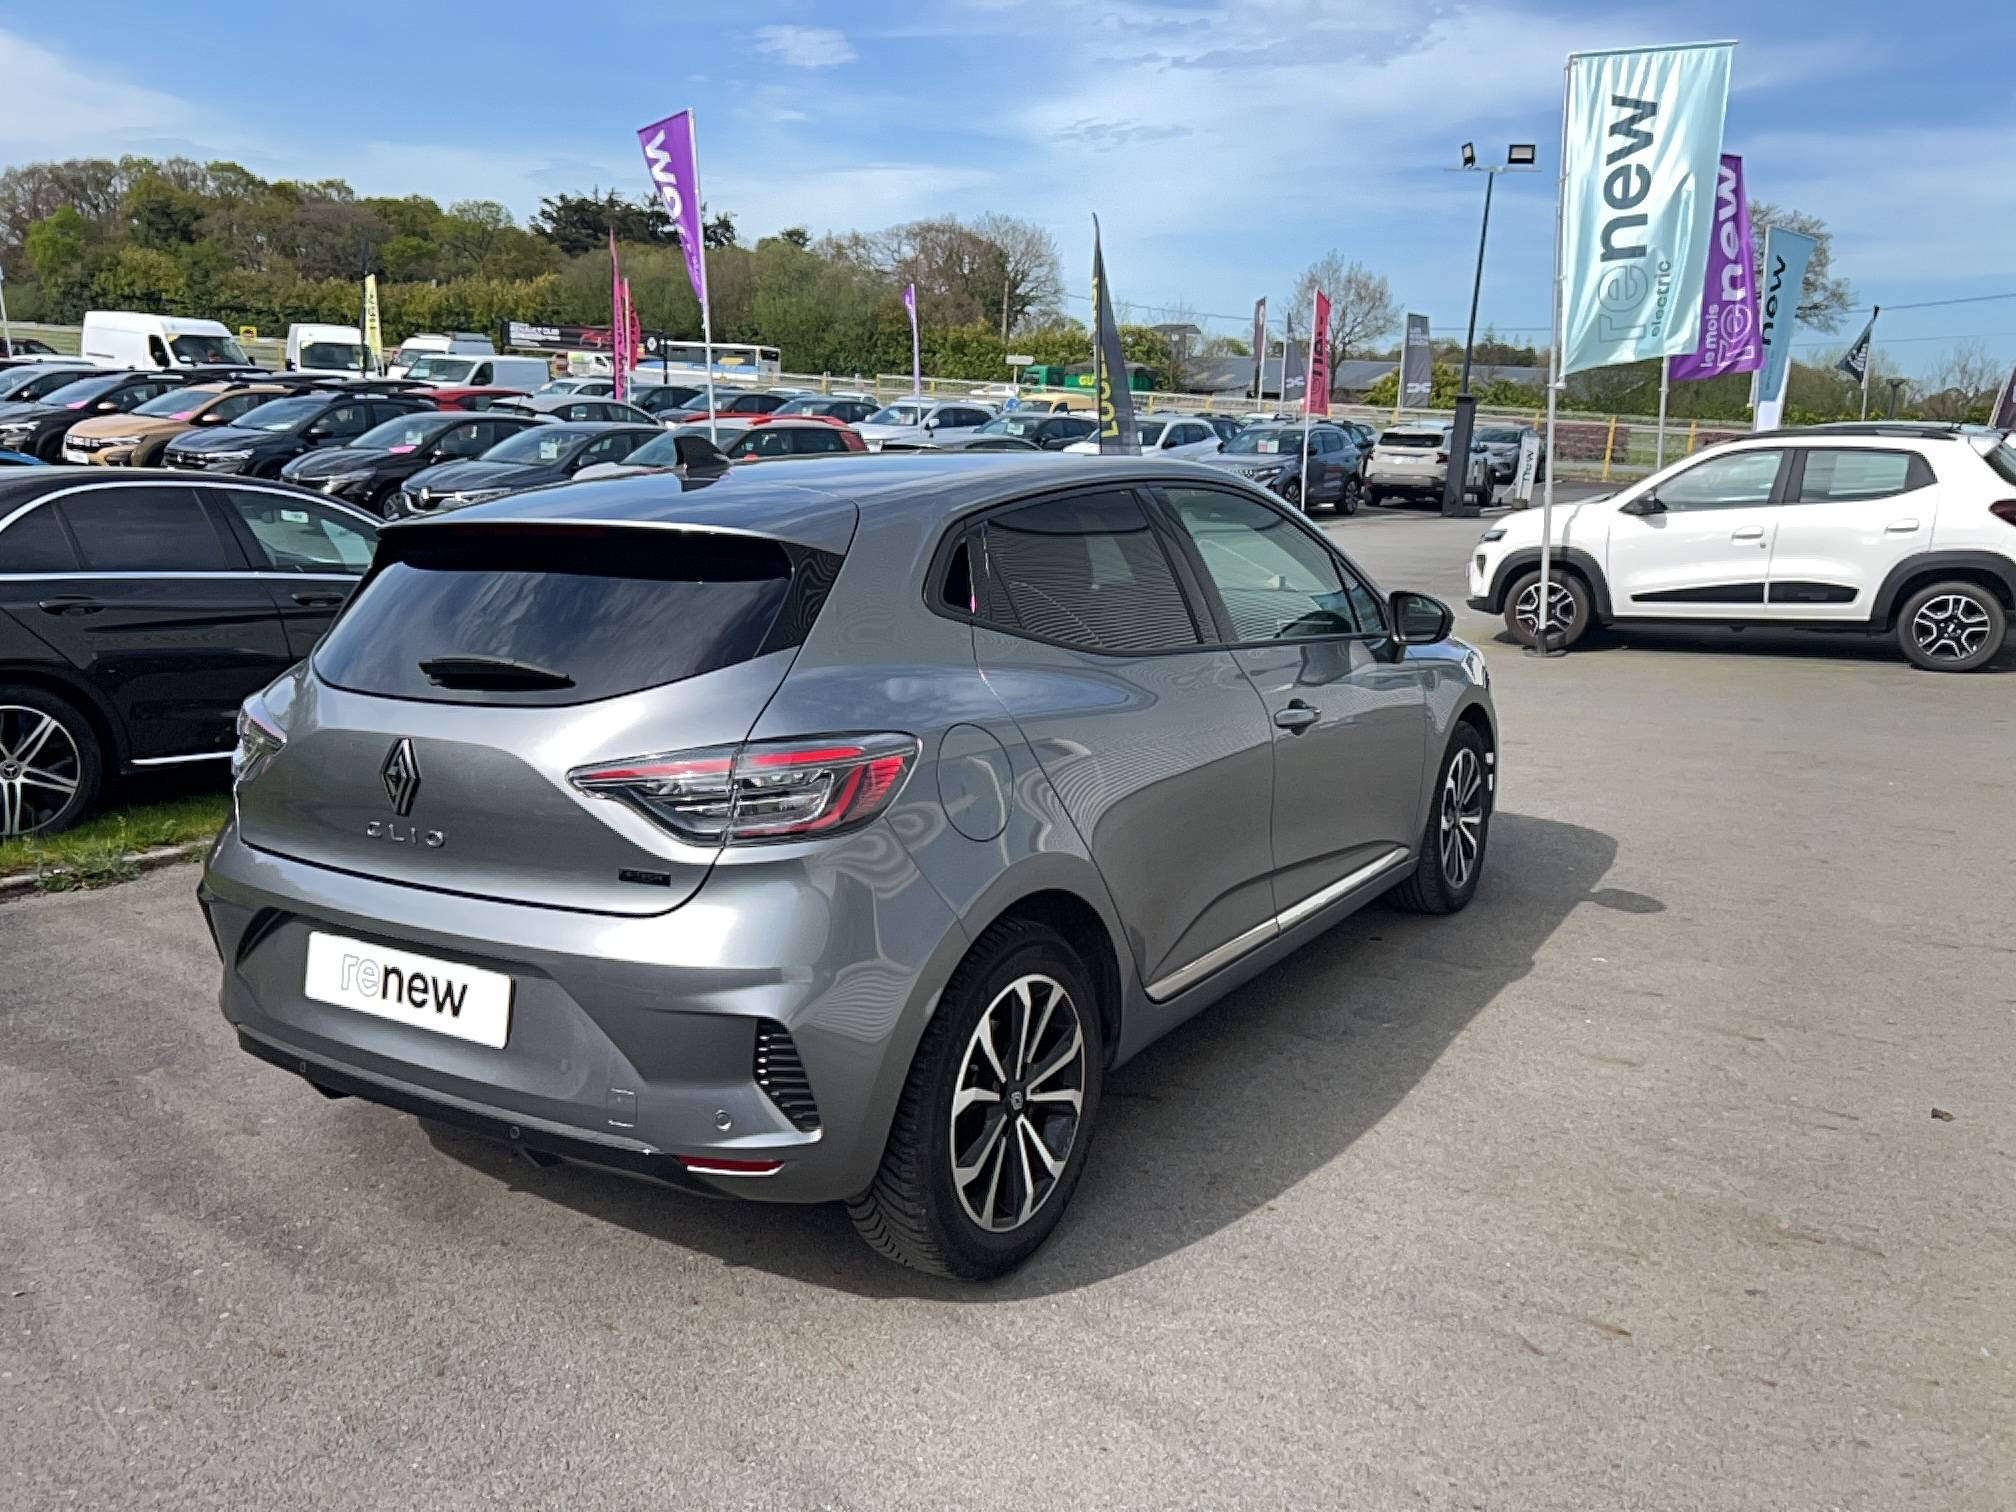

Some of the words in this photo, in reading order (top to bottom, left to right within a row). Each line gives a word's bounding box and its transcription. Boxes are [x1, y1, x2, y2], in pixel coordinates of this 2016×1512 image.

[1598, 94, 1658, 343] renew
[1651, 259, 1672, 337] electric
[1717, 164, 1756, 368] renew
[1705, 303, 1720, 349] mois
[1700, 351, 1716, 368] le
[366, 820, 447, 848] CLIO
[340, 953, 468, 1018] renew
